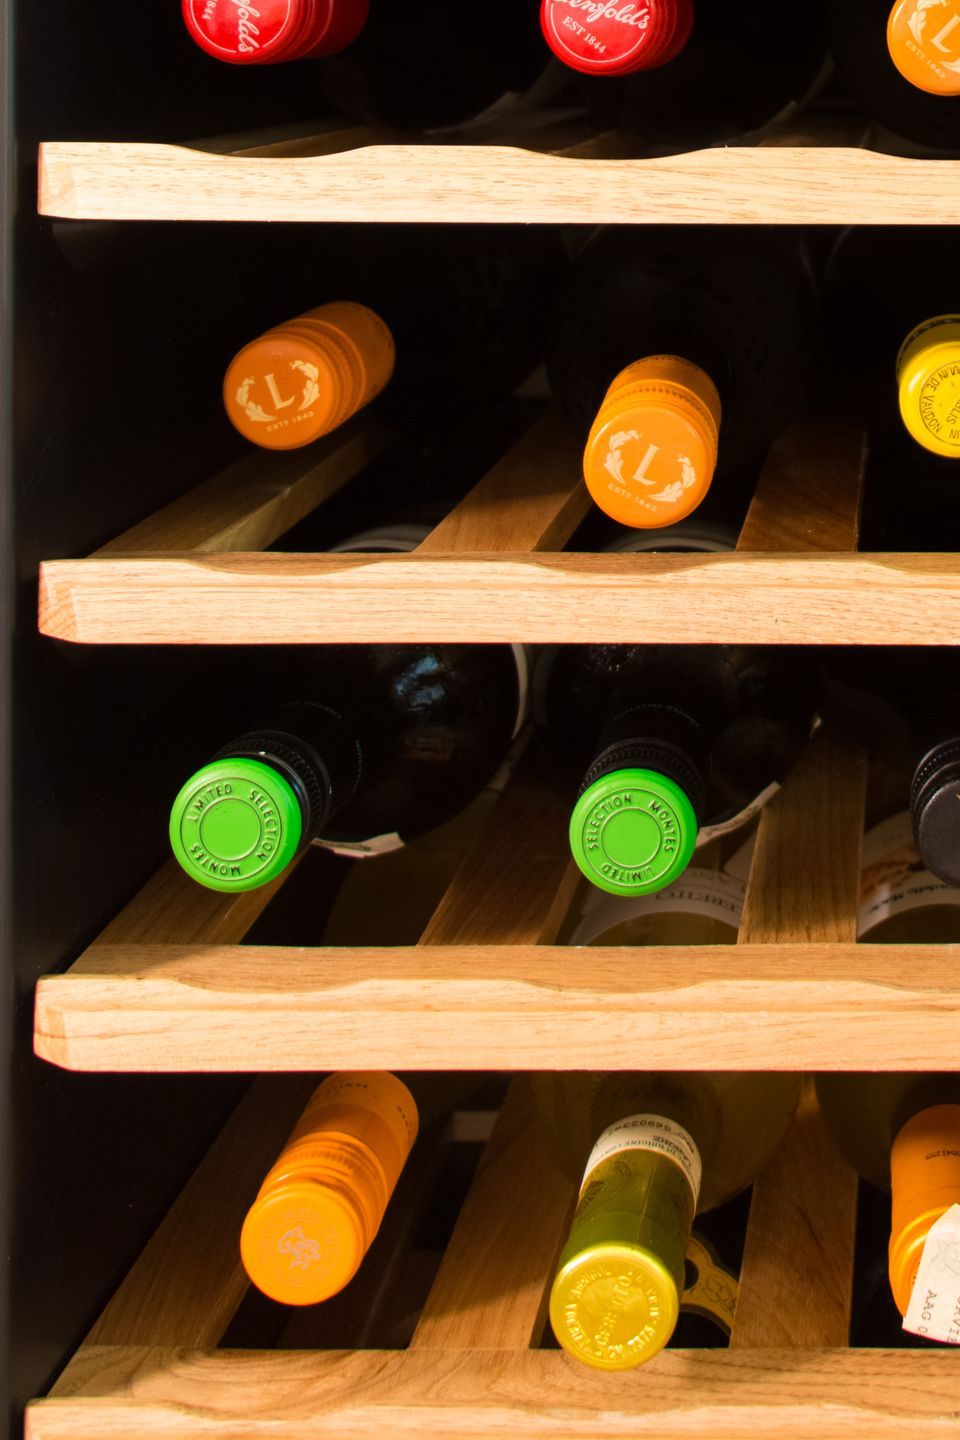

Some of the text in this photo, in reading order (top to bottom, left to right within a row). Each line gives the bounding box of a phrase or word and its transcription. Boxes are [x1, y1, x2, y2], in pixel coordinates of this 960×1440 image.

[562, 16, 607, 54] EST 1844
[926, 380, 940, 393] DE
[186, 783, 278, 862] LIMITED SELECTION
[587, 792, 632, 852] SELECTION
[648, 799, 677, 853] MONTES
[190, 843, 242, 877] MONTES
[601, 863, 655, 882] LIMITED
[920, 1288, 938, 1322] AAG
